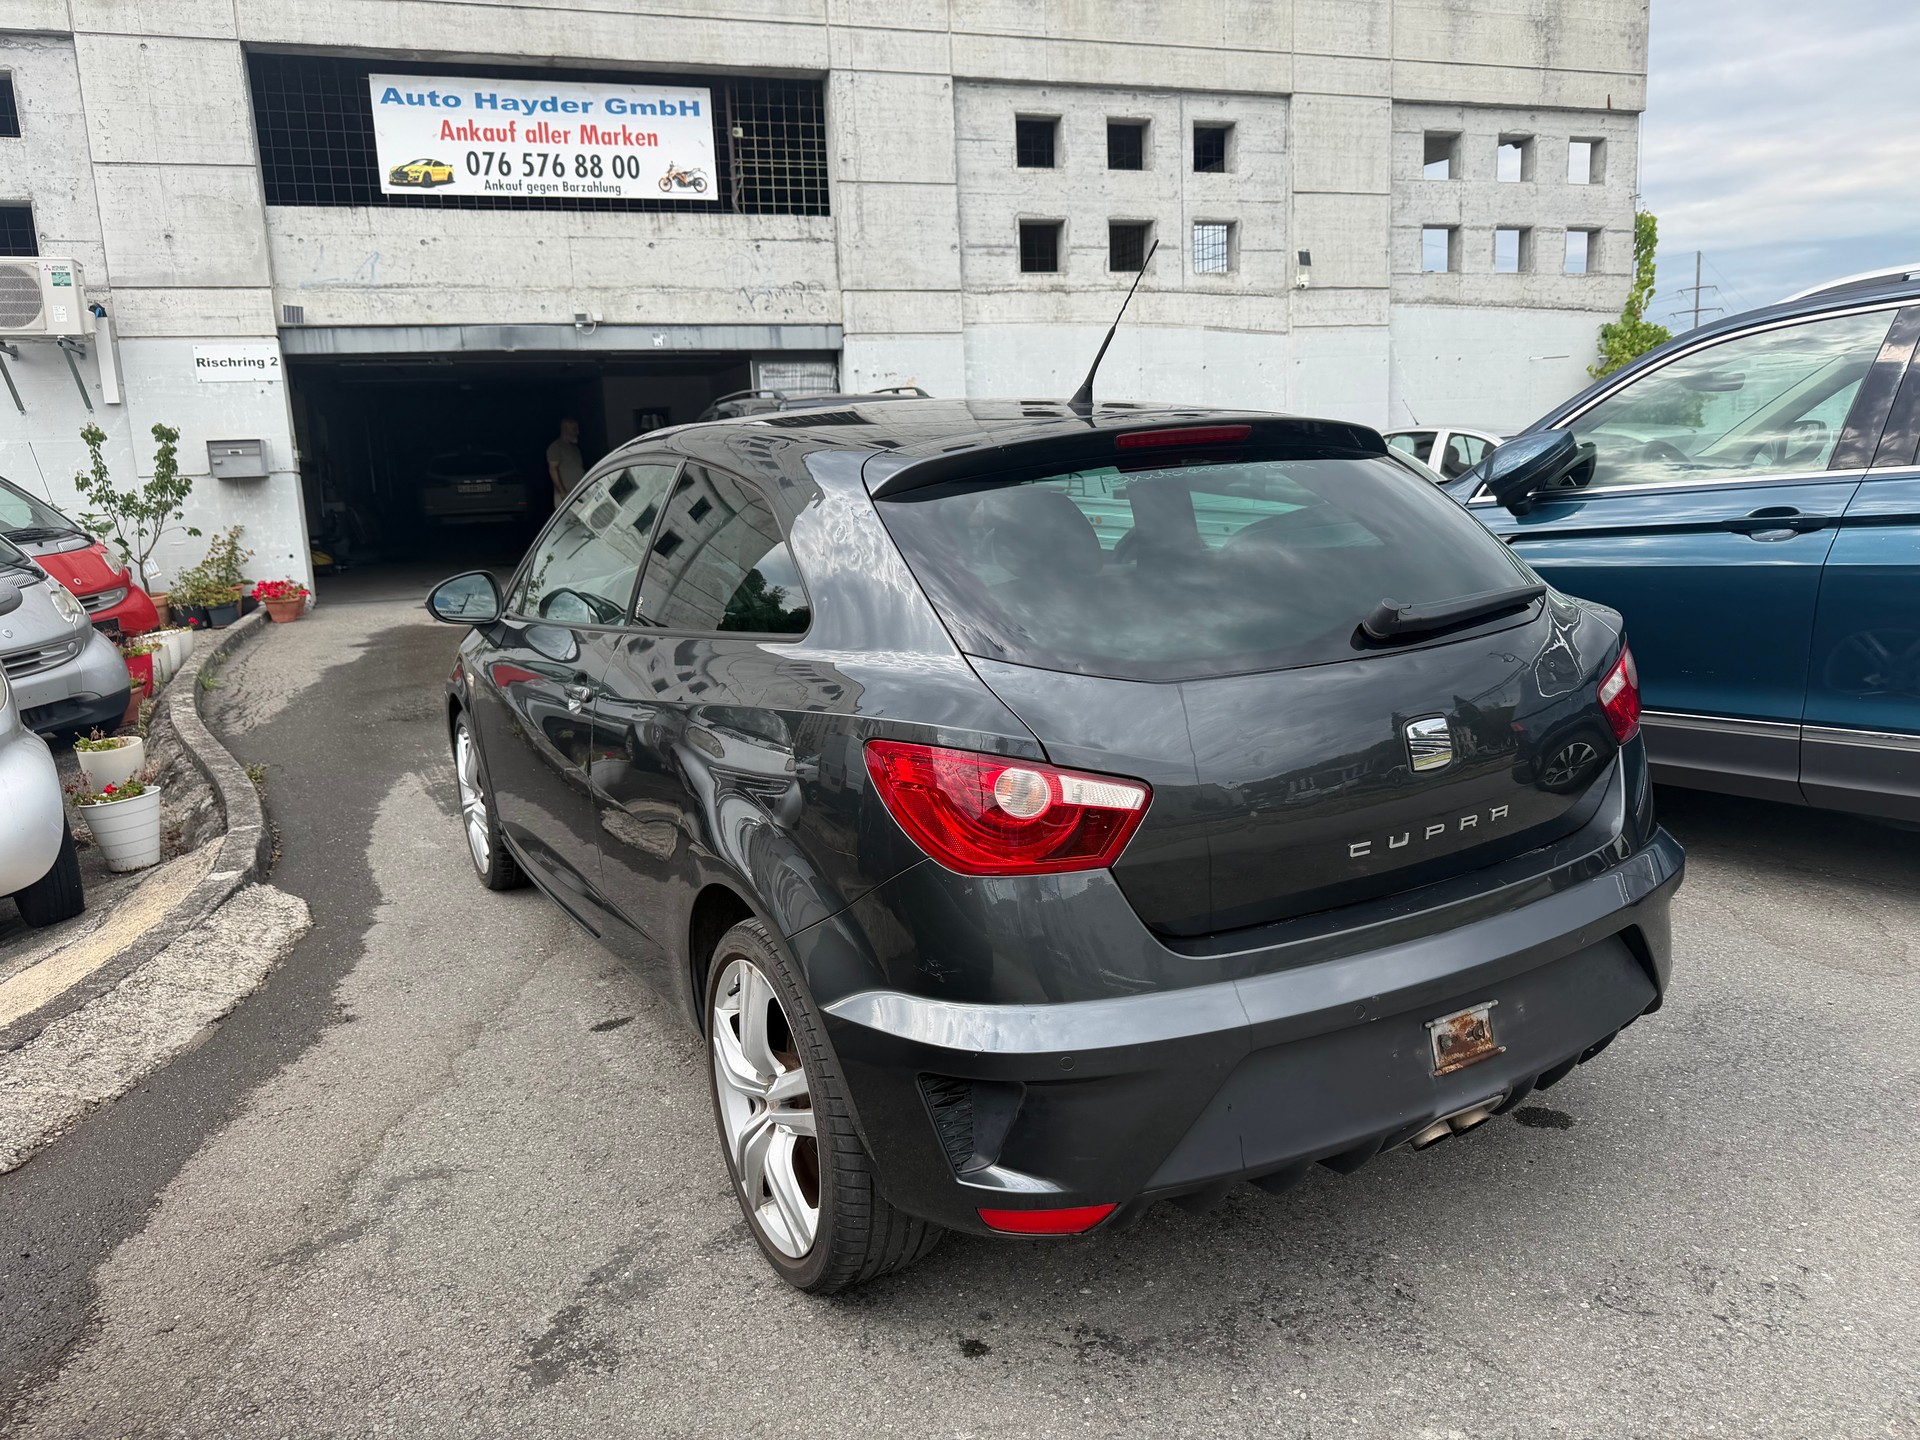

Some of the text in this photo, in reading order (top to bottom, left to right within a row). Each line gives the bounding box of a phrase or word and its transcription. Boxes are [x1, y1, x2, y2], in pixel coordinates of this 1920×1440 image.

[380, 87, 701, 117] Auto Hayder GmbH
[440, 118, 659, 147] Ankauf aller Marken
[466, 150, 641, 180] 076 576 88 00
[484, 179, 622, 196] Ankauf gegen Barzahlung
[196, 356, 279, 369] Rischring 2
[1348, 804, 1509, 858] CUPRA
